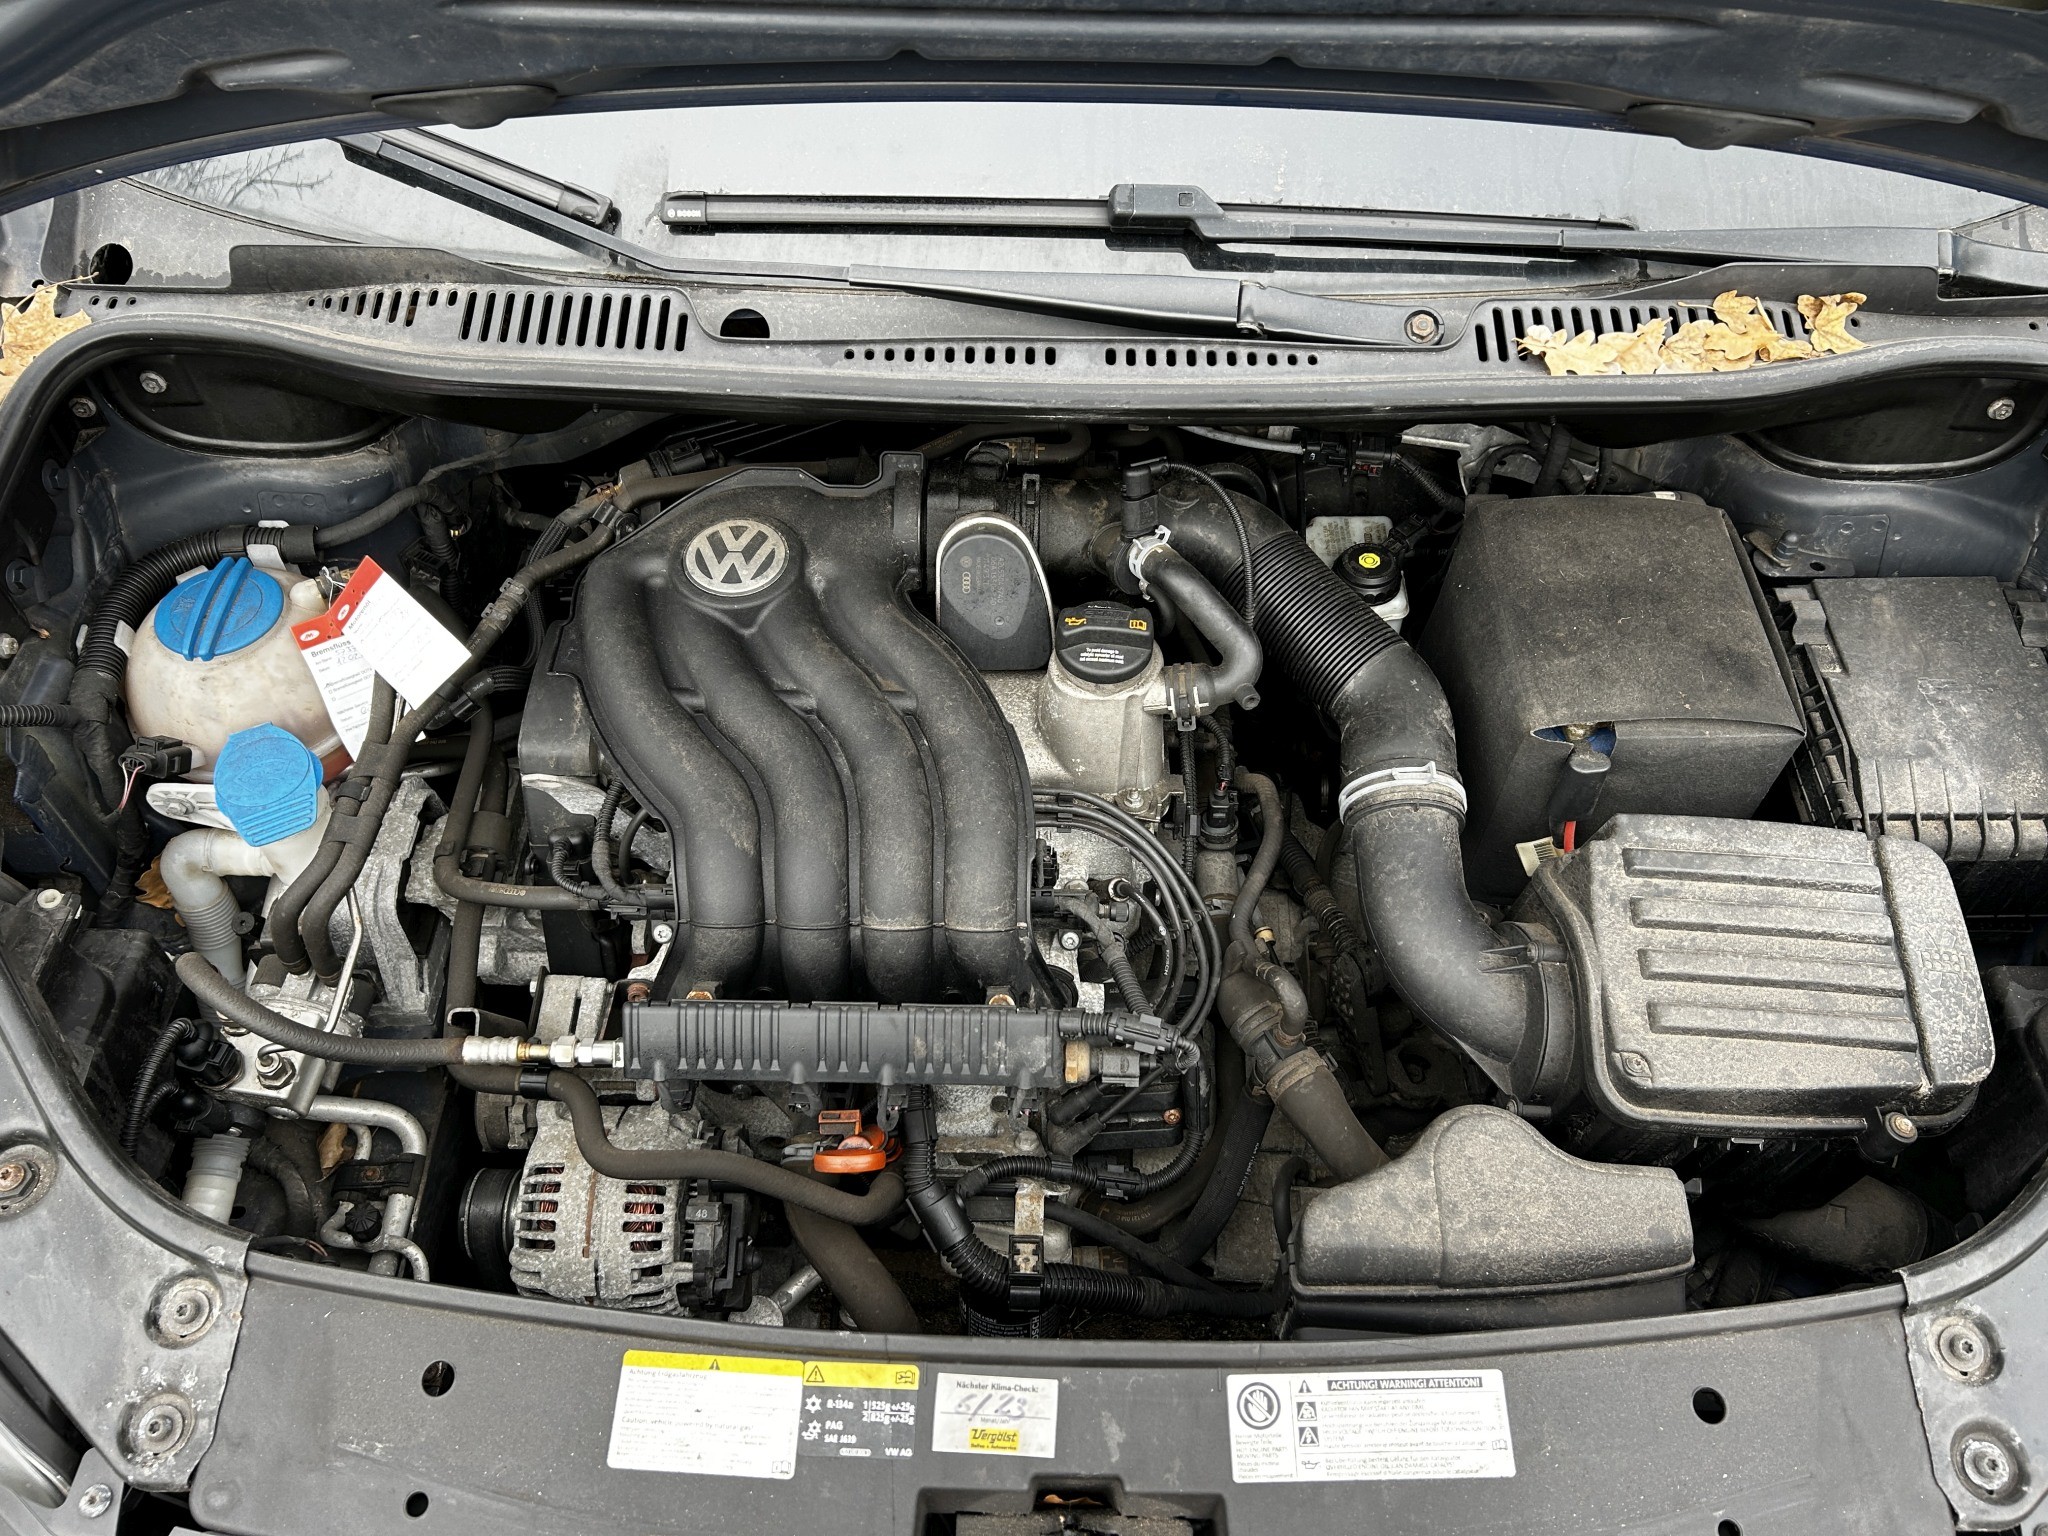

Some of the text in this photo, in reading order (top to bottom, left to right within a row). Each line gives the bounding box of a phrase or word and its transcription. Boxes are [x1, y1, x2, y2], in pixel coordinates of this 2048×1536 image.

[683, 518, 789, 597] VW
[695, 1209, 708, 1218] 48
[1031, 1315, 1040, 1339] OSCH
[956, 1380, 1039, 1393] Nächster Klima-Check:
[1330, 1377, 1480, 1390] ACHTUNG! WARNING! ATTENTION!
[825, 1420, 844, 1430] PAG
[971, 1428, 1018, 1444] Vergölst
[884, 1447, 913, 1457] VW AG
